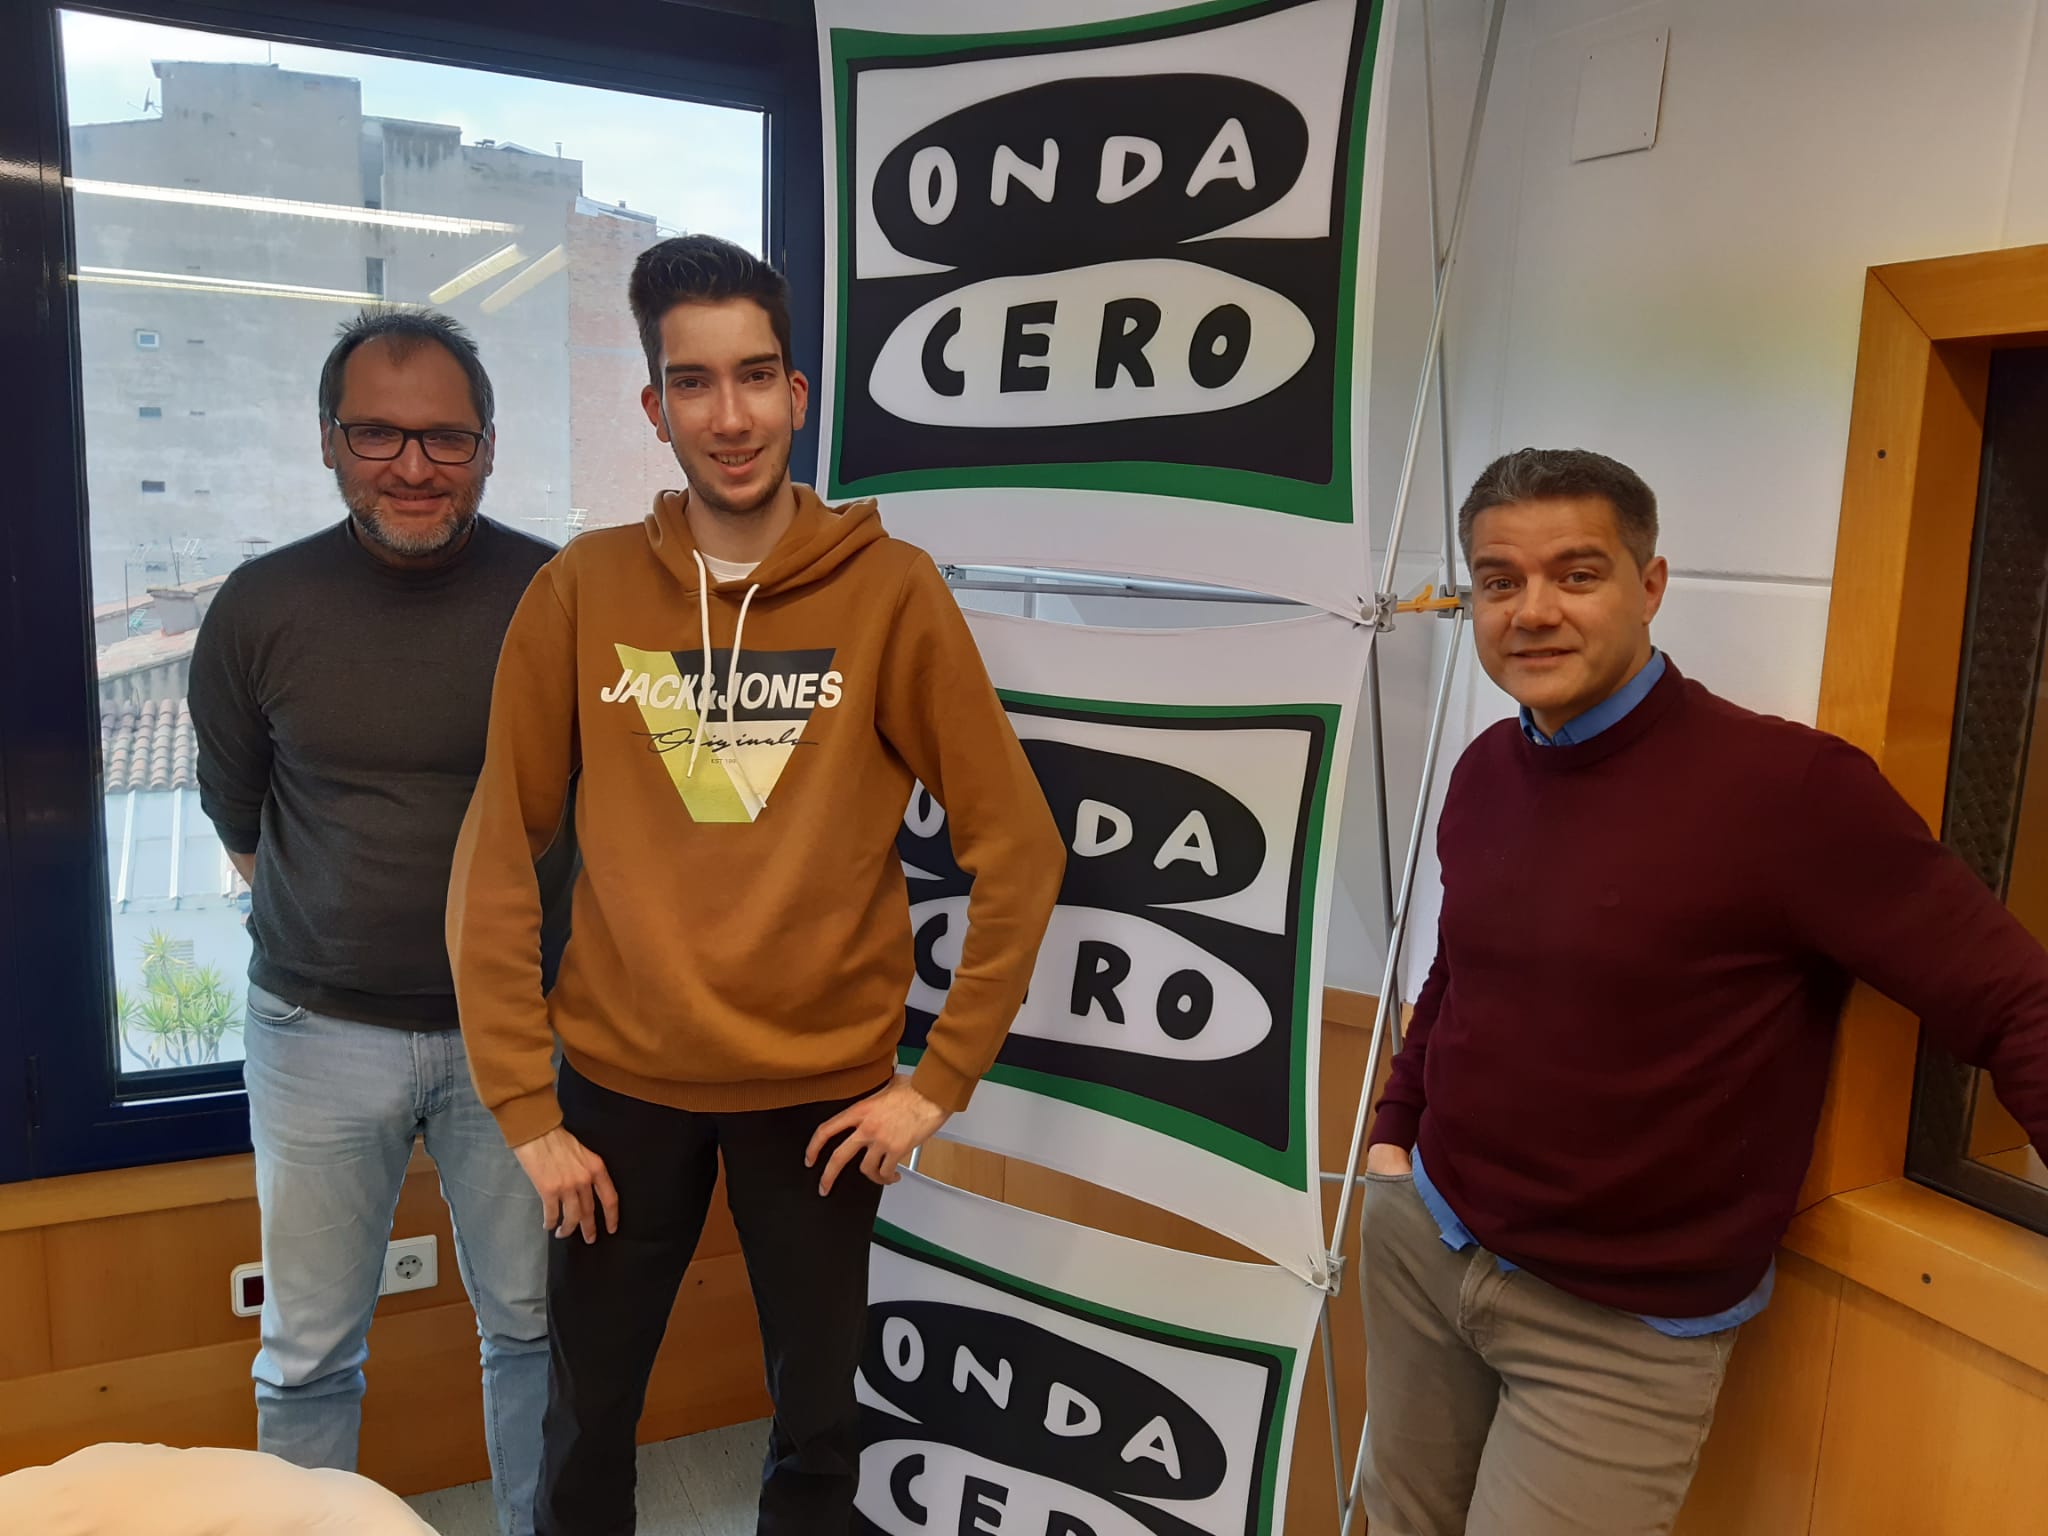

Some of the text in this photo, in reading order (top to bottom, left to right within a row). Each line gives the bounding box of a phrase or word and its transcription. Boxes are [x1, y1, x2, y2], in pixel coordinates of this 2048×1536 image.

[908, 117, 1257, 225] ONDA
[920, 297, 1252, 397] CERO
[903, 776, 1219, 877] ODA
[913, 912, 1215, 1041] CRO
[881, 1316, 1183, 1481] ONDA
